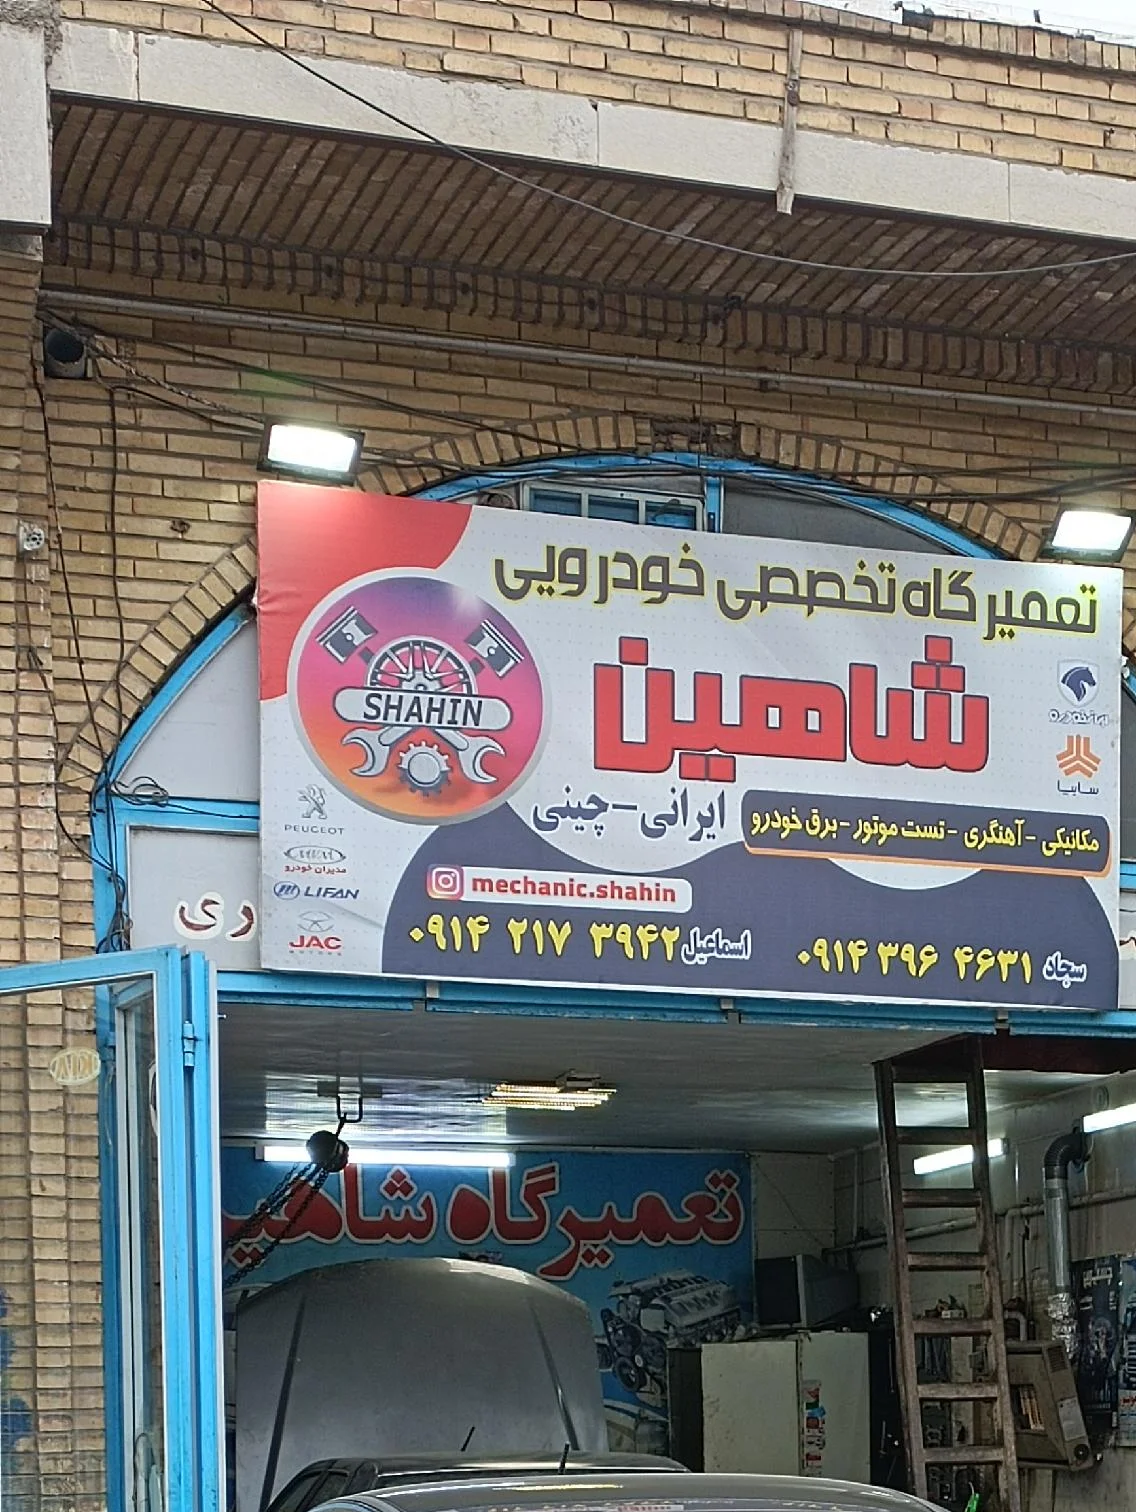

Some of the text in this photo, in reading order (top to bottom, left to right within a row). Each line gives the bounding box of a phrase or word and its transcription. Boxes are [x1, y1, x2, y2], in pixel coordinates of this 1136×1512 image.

[495, 542, 705, 604] خودرویی
[716, 560, 896, 621] تخصصی
[363, 692, 482, 727] SHAHIN
[593, 635, 989, 783] شاهین
[284, 824, 345, 835] PEUGEOT
[750, 806, 802, 839] خودرو
[805, 812, 838, 840] برق
[853, 814, 898, 845] موتور
[1041, 826, 1100, 856] مکانیکی
[304, 885, 360, 900] LIFAN
[472, 875, 676, 904] mechanic.shahin
[288, 934, 343, 950] JAC
[507, 917, 572, 956] ۲۱۷
[681, 926, 752, 965] اسماعیل
[876, 940, 938, 979] ۳۹۶
[1042, 950, 1088, 988] سجاد
[222, 1162, 437, 1268] شاهی
